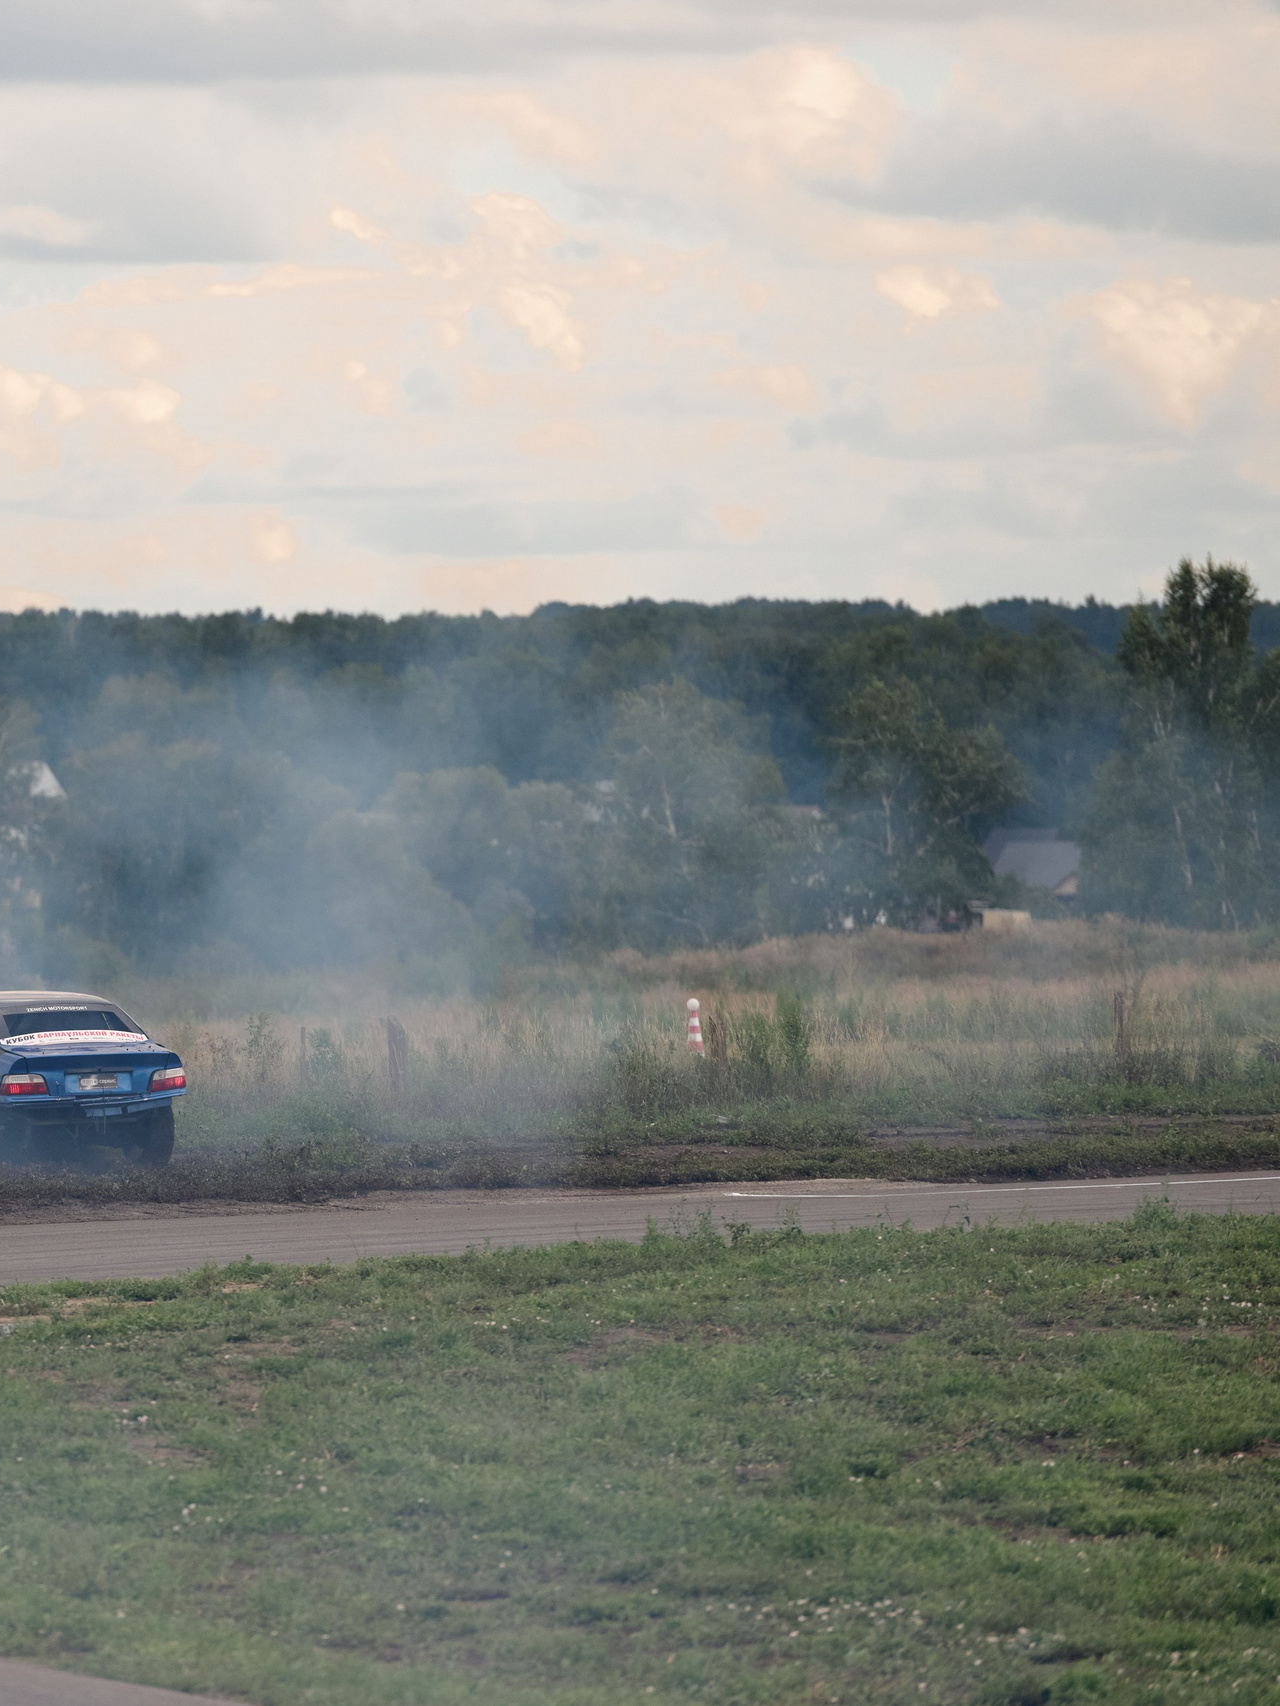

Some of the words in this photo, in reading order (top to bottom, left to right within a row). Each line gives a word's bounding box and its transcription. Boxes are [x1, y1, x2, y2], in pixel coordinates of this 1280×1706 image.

[6, 1034, 35, 1045] КУБОК
[37, 1031, 107, 1039] БАРНАУЛЬСКОЙ
[110, 1032, 144, 1041] РАКЕТЫ
